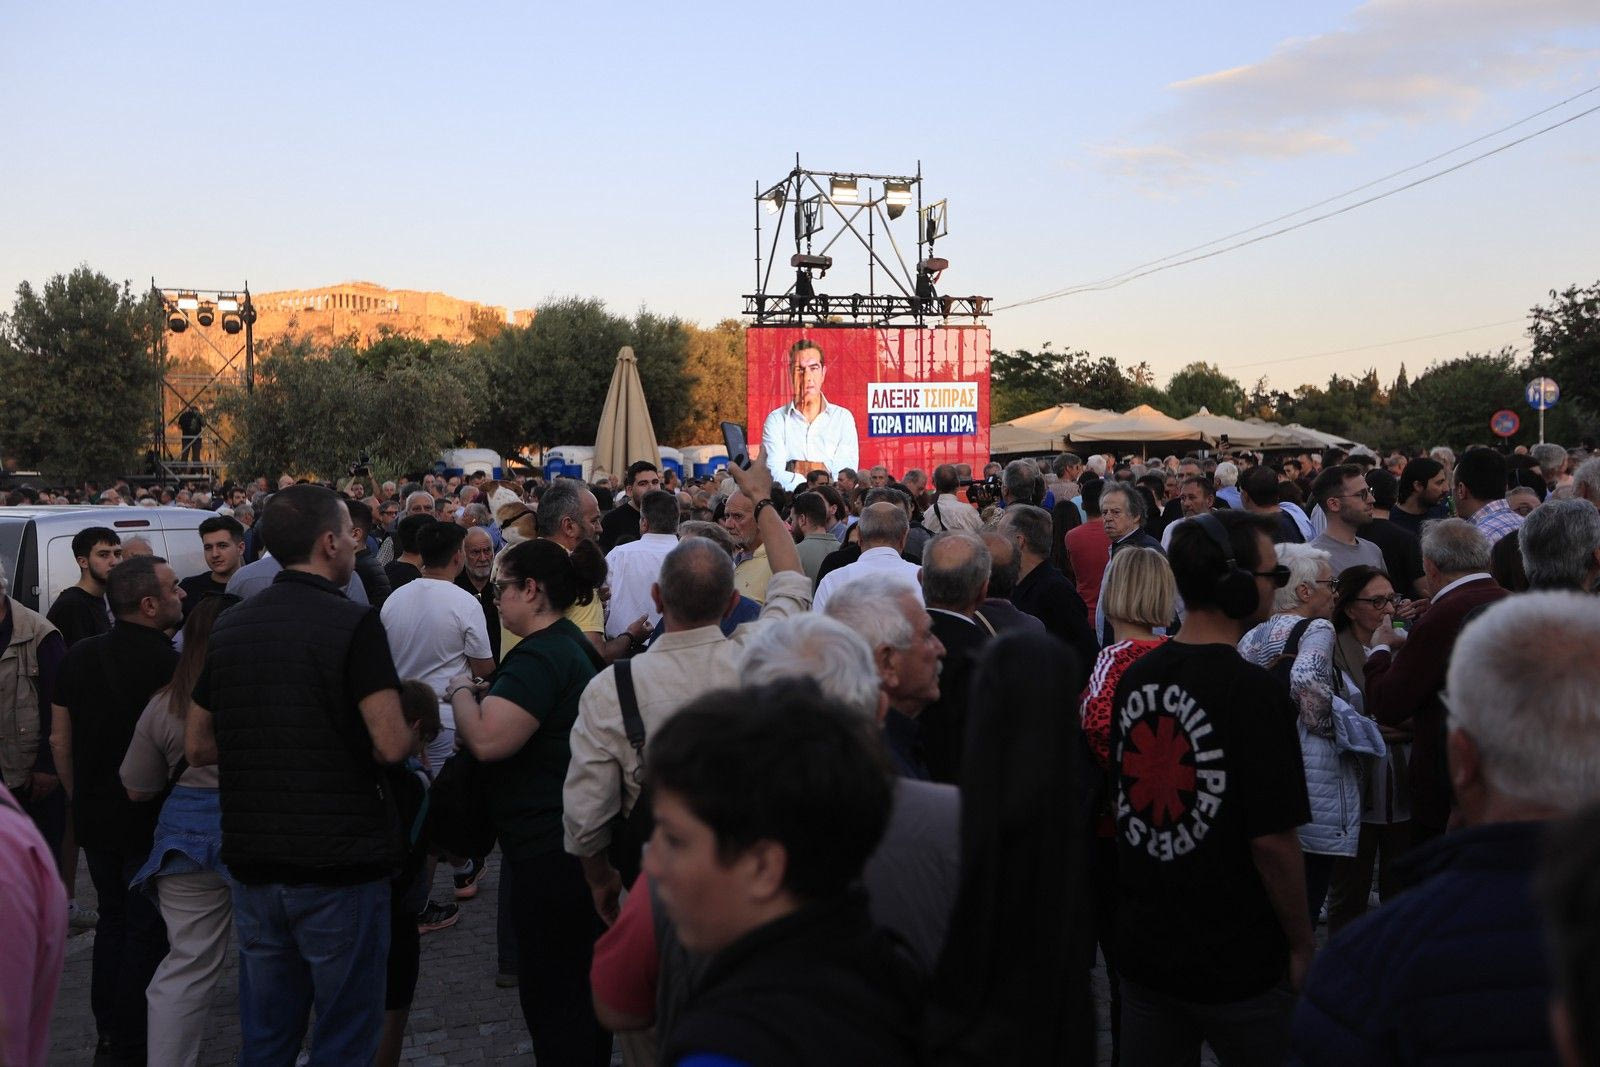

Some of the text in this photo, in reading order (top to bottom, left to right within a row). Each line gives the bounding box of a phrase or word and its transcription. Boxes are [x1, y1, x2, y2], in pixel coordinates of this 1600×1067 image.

[872, 388, 975, 408] ΑΛΕΞΗΣ ΤΣΙΠΡΑΣ
[871, 414, 974, 434] ΤΩΡΑ ΕΙΝΑΙ Η ΩΡΑ
[1162, 684, 1224, 762] CHILI
[1124, 769, 1226, 861] PEPPERS
